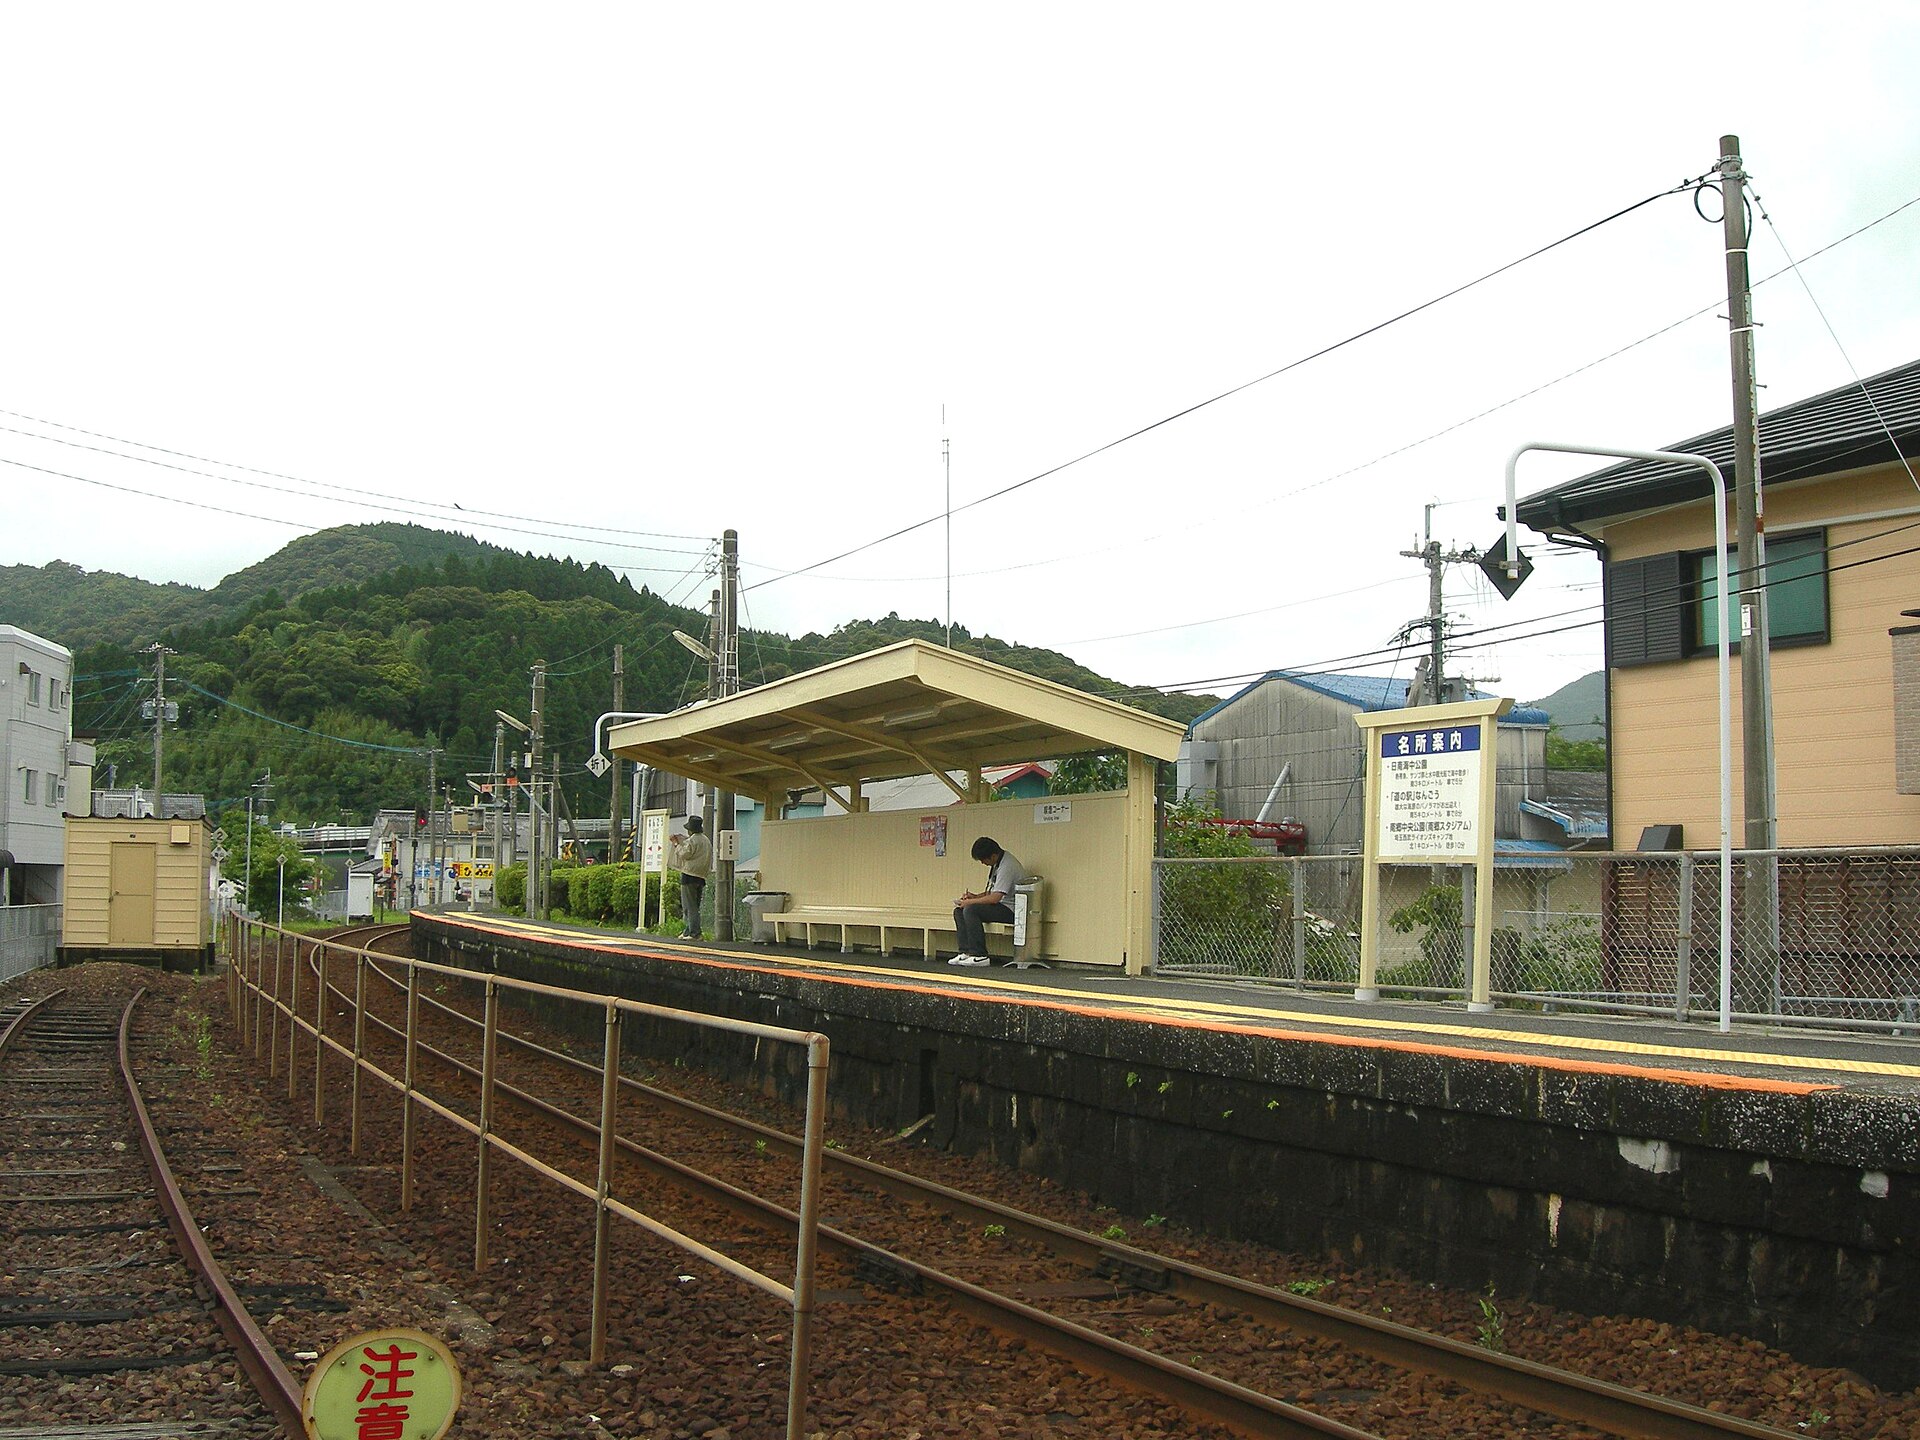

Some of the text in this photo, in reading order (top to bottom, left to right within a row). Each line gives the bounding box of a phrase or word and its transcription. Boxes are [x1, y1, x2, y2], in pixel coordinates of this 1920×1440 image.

[1397, 730, 1462, 755] 名所案内
[216, 831, 223, 840] 2
[354, 1344, 418, 1440] 注意
